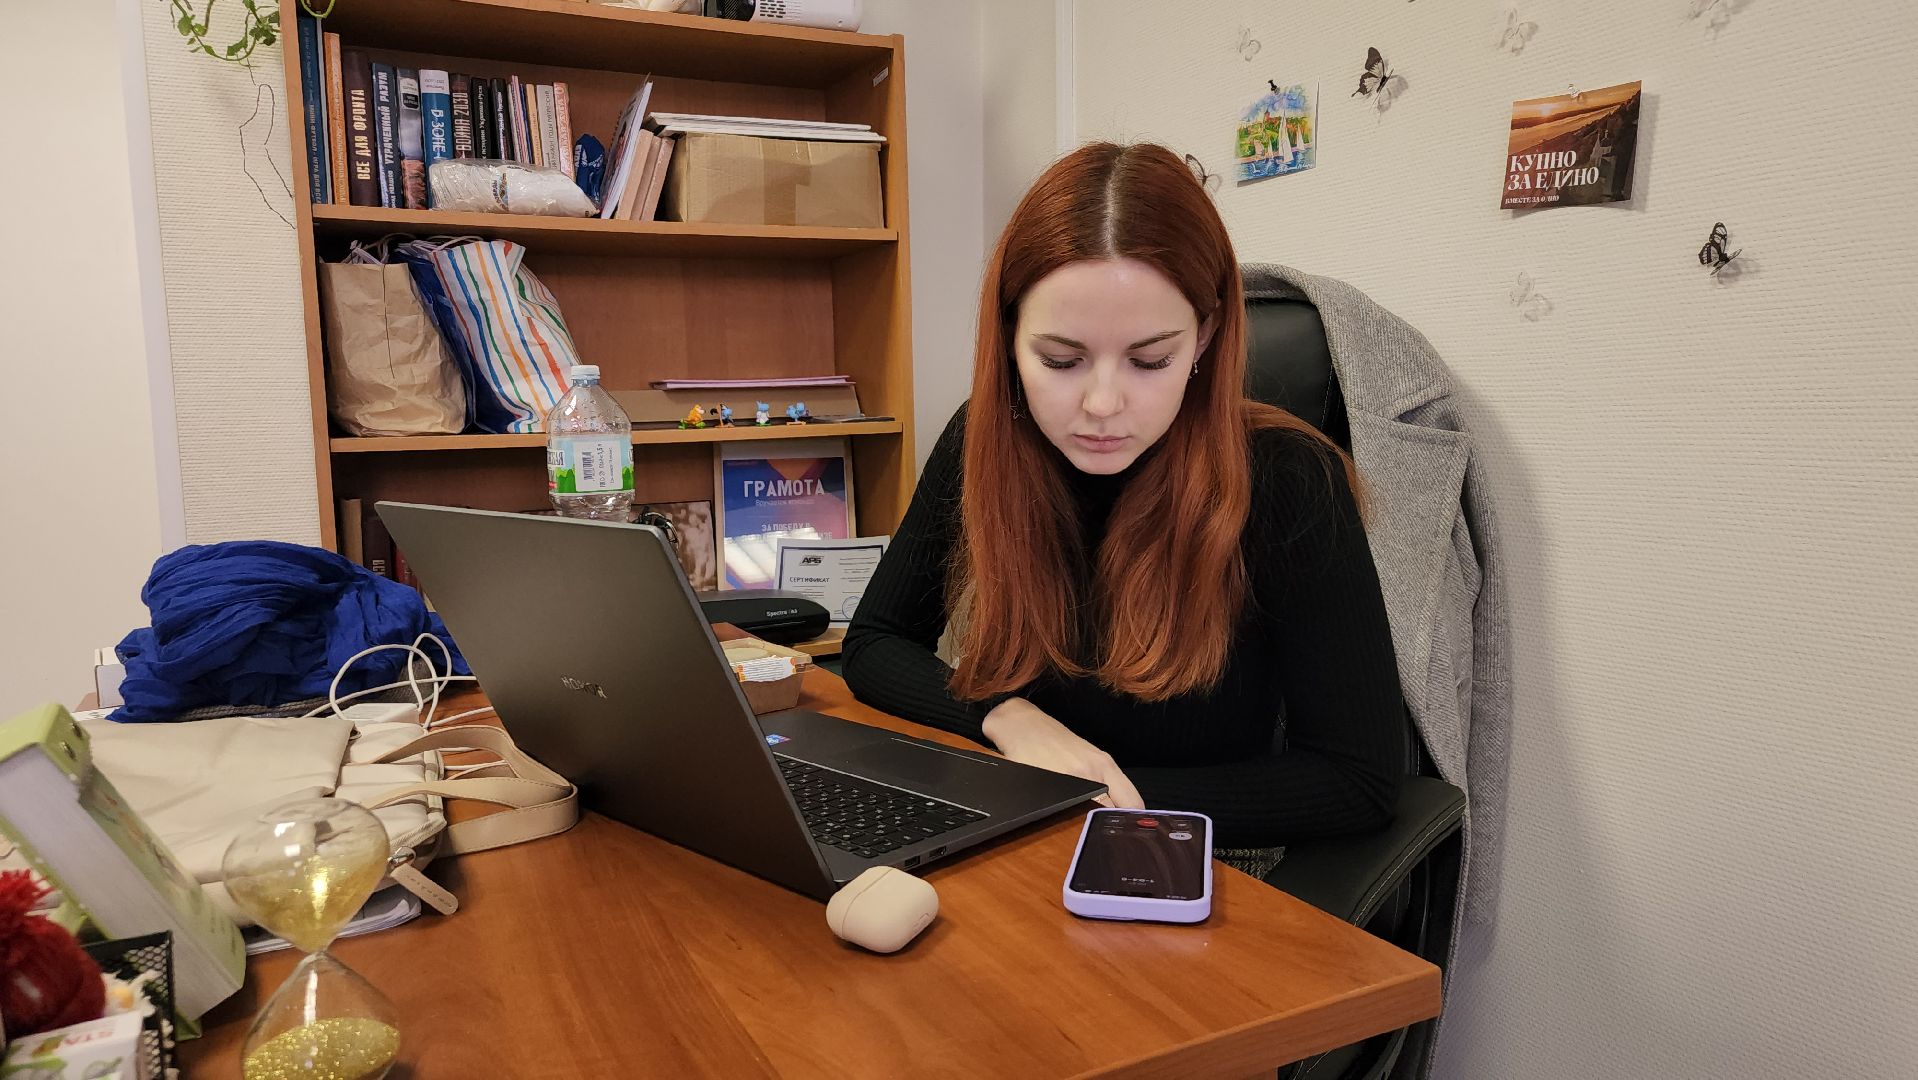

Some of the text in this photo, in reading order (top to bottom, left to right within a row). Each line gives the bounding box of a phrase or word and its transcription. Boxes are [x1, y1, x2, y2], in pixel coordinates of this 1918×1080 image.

[378, 72, 389, 102] РАЗУМ
[351, 89, 371, 180] ВСЕ ДЛЯ ФРОНТА
[378, 105, 394, 164] УТРАЧЕННЫЙ
[453, 92, 472, 151] ВОЙНА 2030
[433, 122, 446, 153] ЗОНЕ
[1510, 150, 1577, 173] КУПНО
[1507, 166, 1599, 191] ЗА ЕДИНО
[743, 479, 825, 498] ГРАМОТА
[761, 524, 772, 532] ЗА
